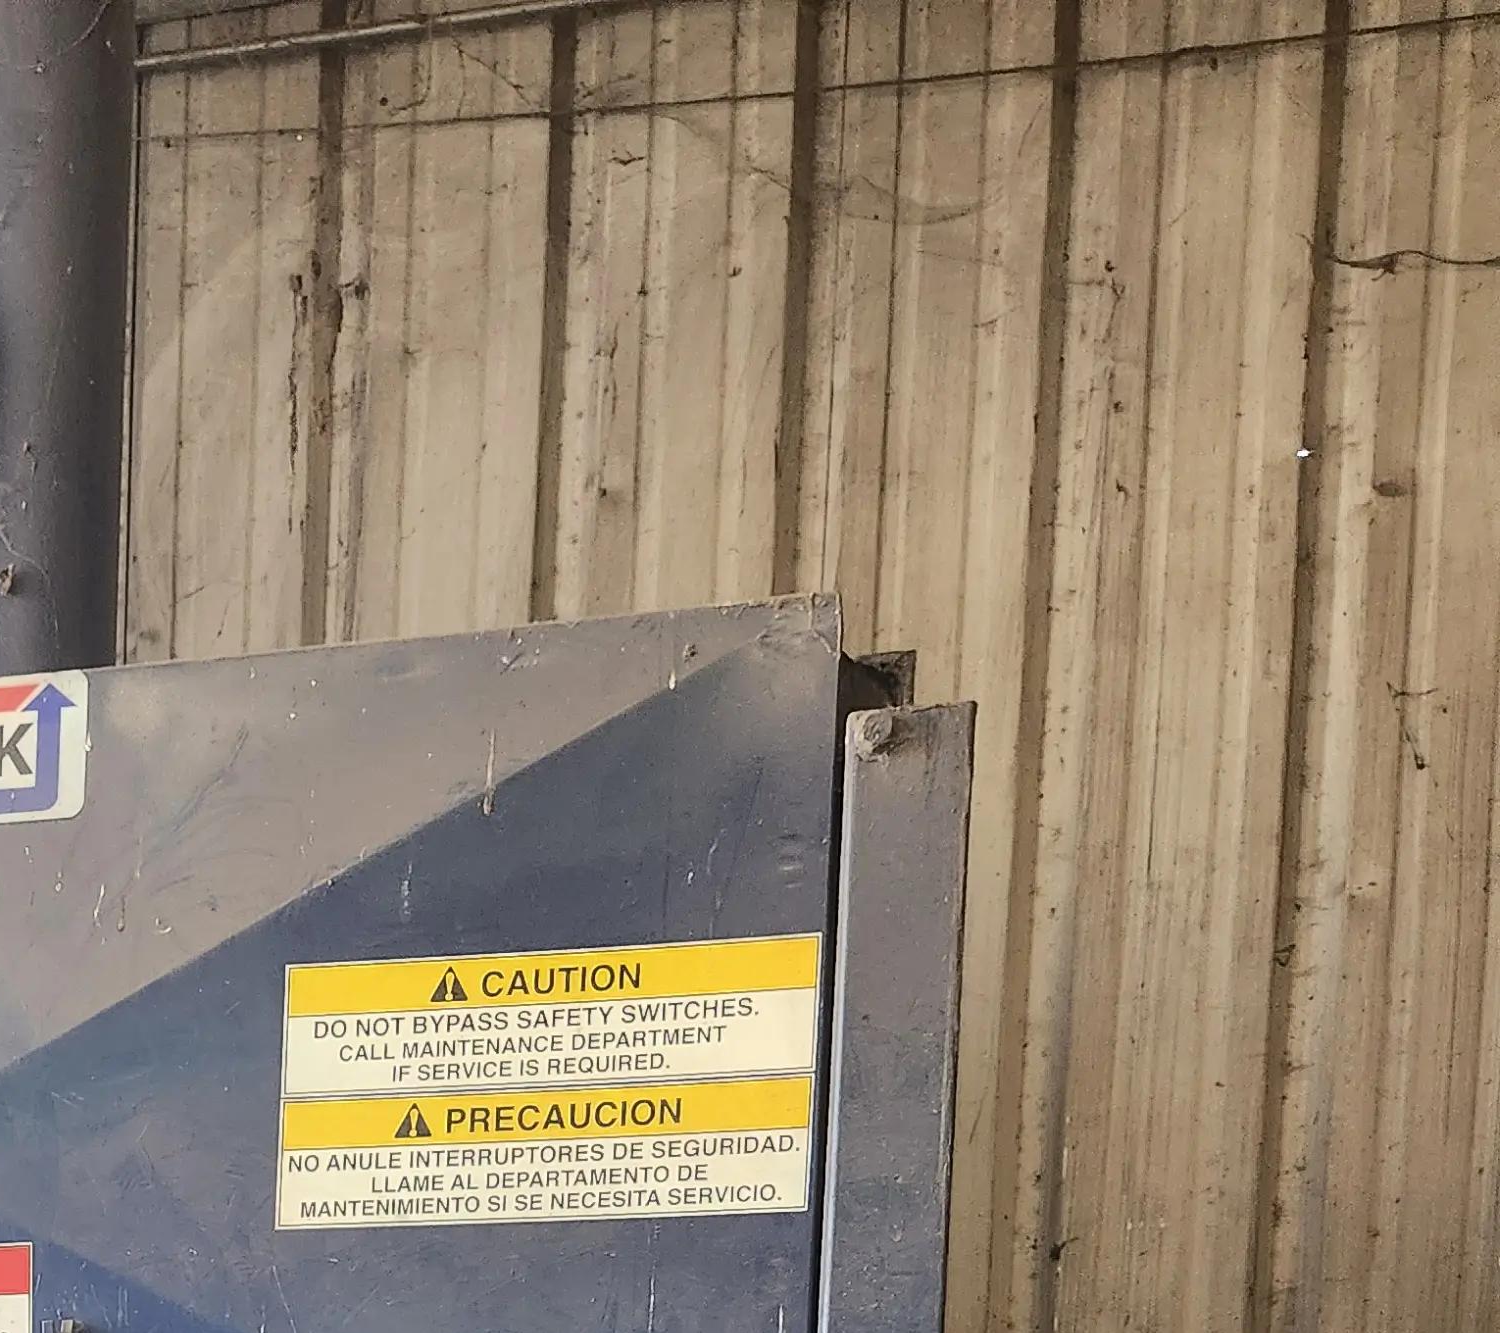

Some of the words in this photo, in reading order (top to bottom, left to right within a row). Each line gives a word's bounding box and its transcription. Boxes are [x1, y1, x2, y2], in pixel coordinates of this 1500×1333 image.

[482, 964, 640, 998] CAUTION
[314, 1019, 346, 1038] DO
[356, 1017, 405, 1036] NOT
[413, 1011, 508, 1033] BYPASS
[517, 1002, 613, 1028] SAFETY
[621, 997, 758, 1023] SWITCHES.
[339, 1043, 395, 1061] CALL
[402, 1035, 562, 1057] MAINTENANCE
[571, 1025, 726, 1050] DEPARTMENT
[392, 1065, 410, 1081] IF
[417, 1060, 511, 1080] SERVICE
[520, 1059, 538, 1075] IS
[547, 1053, 669, 1074] REQUIRED.
[446, 1098, 681, 1133] PRECAUCION
[288, 1154, 319, 1172] NO
[326, 1152, 401, 1170] ANULE
[409, 1144, 604, 1167] INTERRUPTORES
[613, 1141, 643, 1160] DE
[651, 1135, 799, 1158] SEGURIDAD.
[371, 1174, 443, 1192] LLAME
[450, 1173, 478, 1190] AL
[486, 1166, 669, 1188] DEPARTAMENTO
[678, 1163, 708, 1181] DE
[300, 1196, 479, 1217] MANTENIMIENTO
[487, 1195, 506, 1212] SI
[514, 1193, 542, 1211] SE
[550, 1189, 660, 1209] NECESITA
[667, 1184, 781, 1205] SERVICIO.
